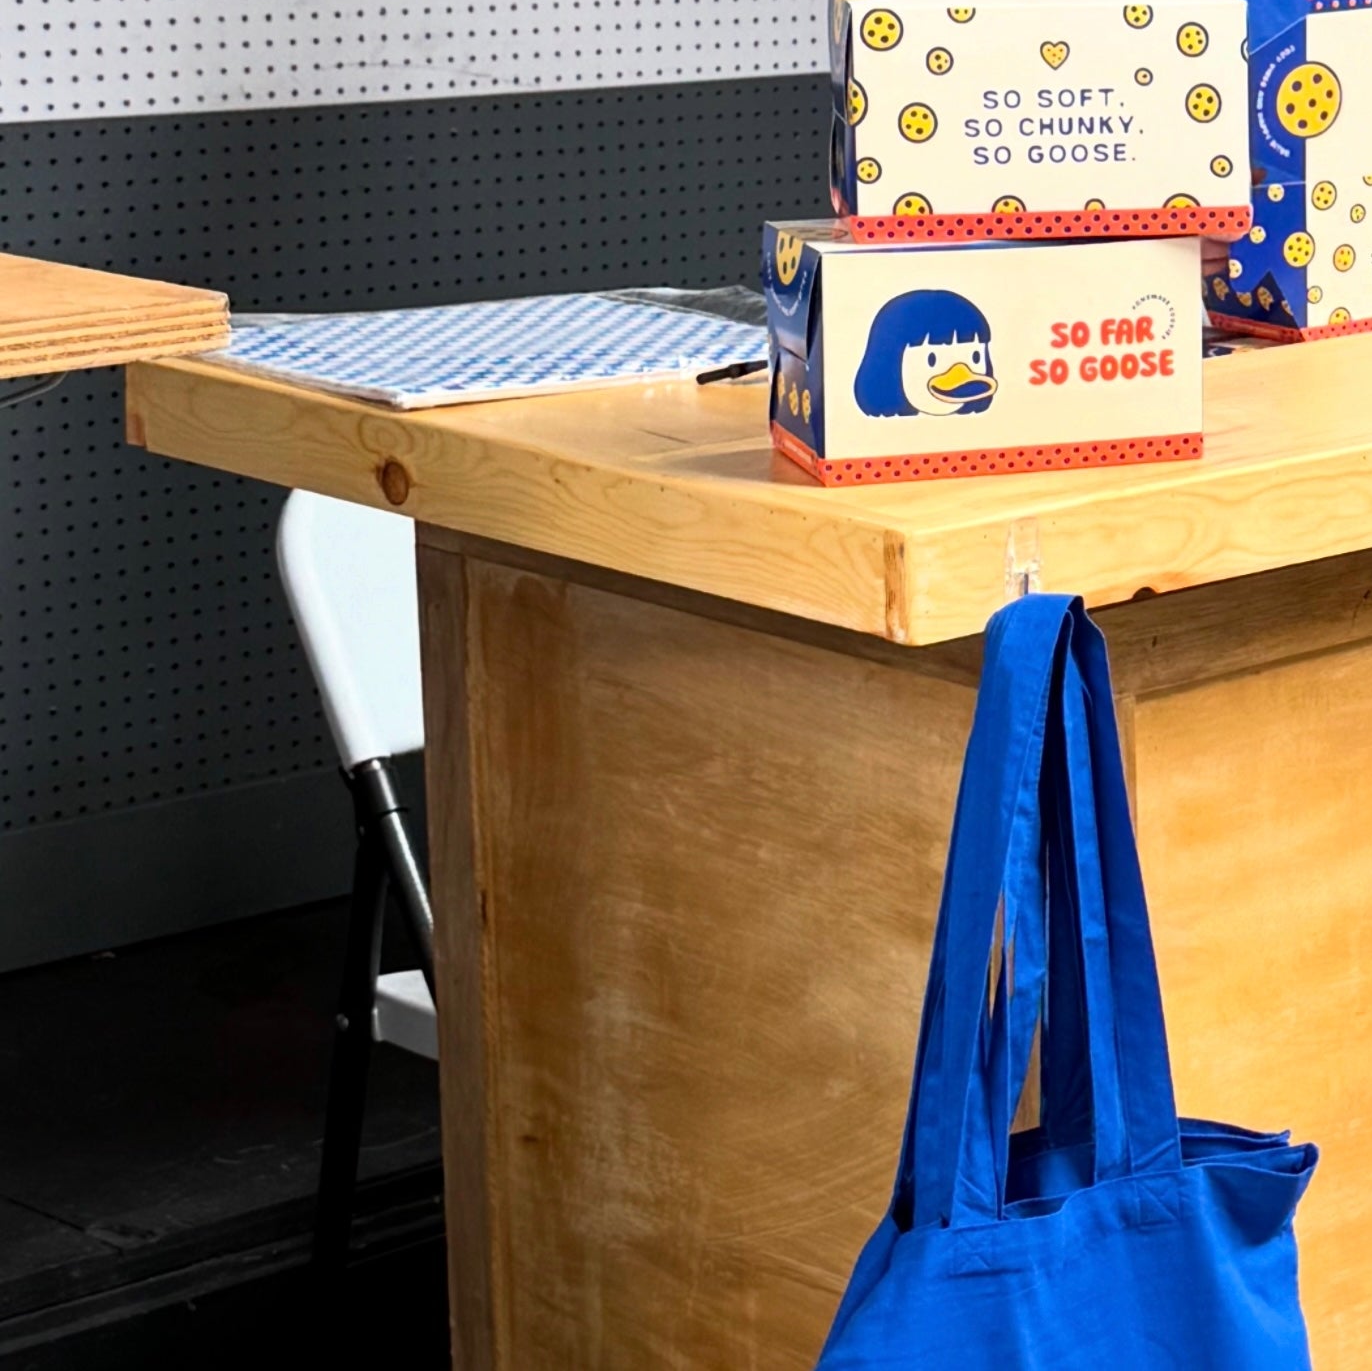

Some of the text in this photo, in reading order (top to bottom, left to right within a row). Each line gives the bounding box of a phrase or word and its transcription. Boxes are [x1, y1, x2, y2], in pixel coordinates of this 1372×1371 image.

[983, 88, 1124, 109] SO SOFT.
[964, 115, 1143, 137] SO CHUNKY.
[973, 143, 1136, 165] SO GOOSE.
[1050, 315, 1155, 349] SO FAR
[1028, 349, 1175, 386] SO GOOSE
